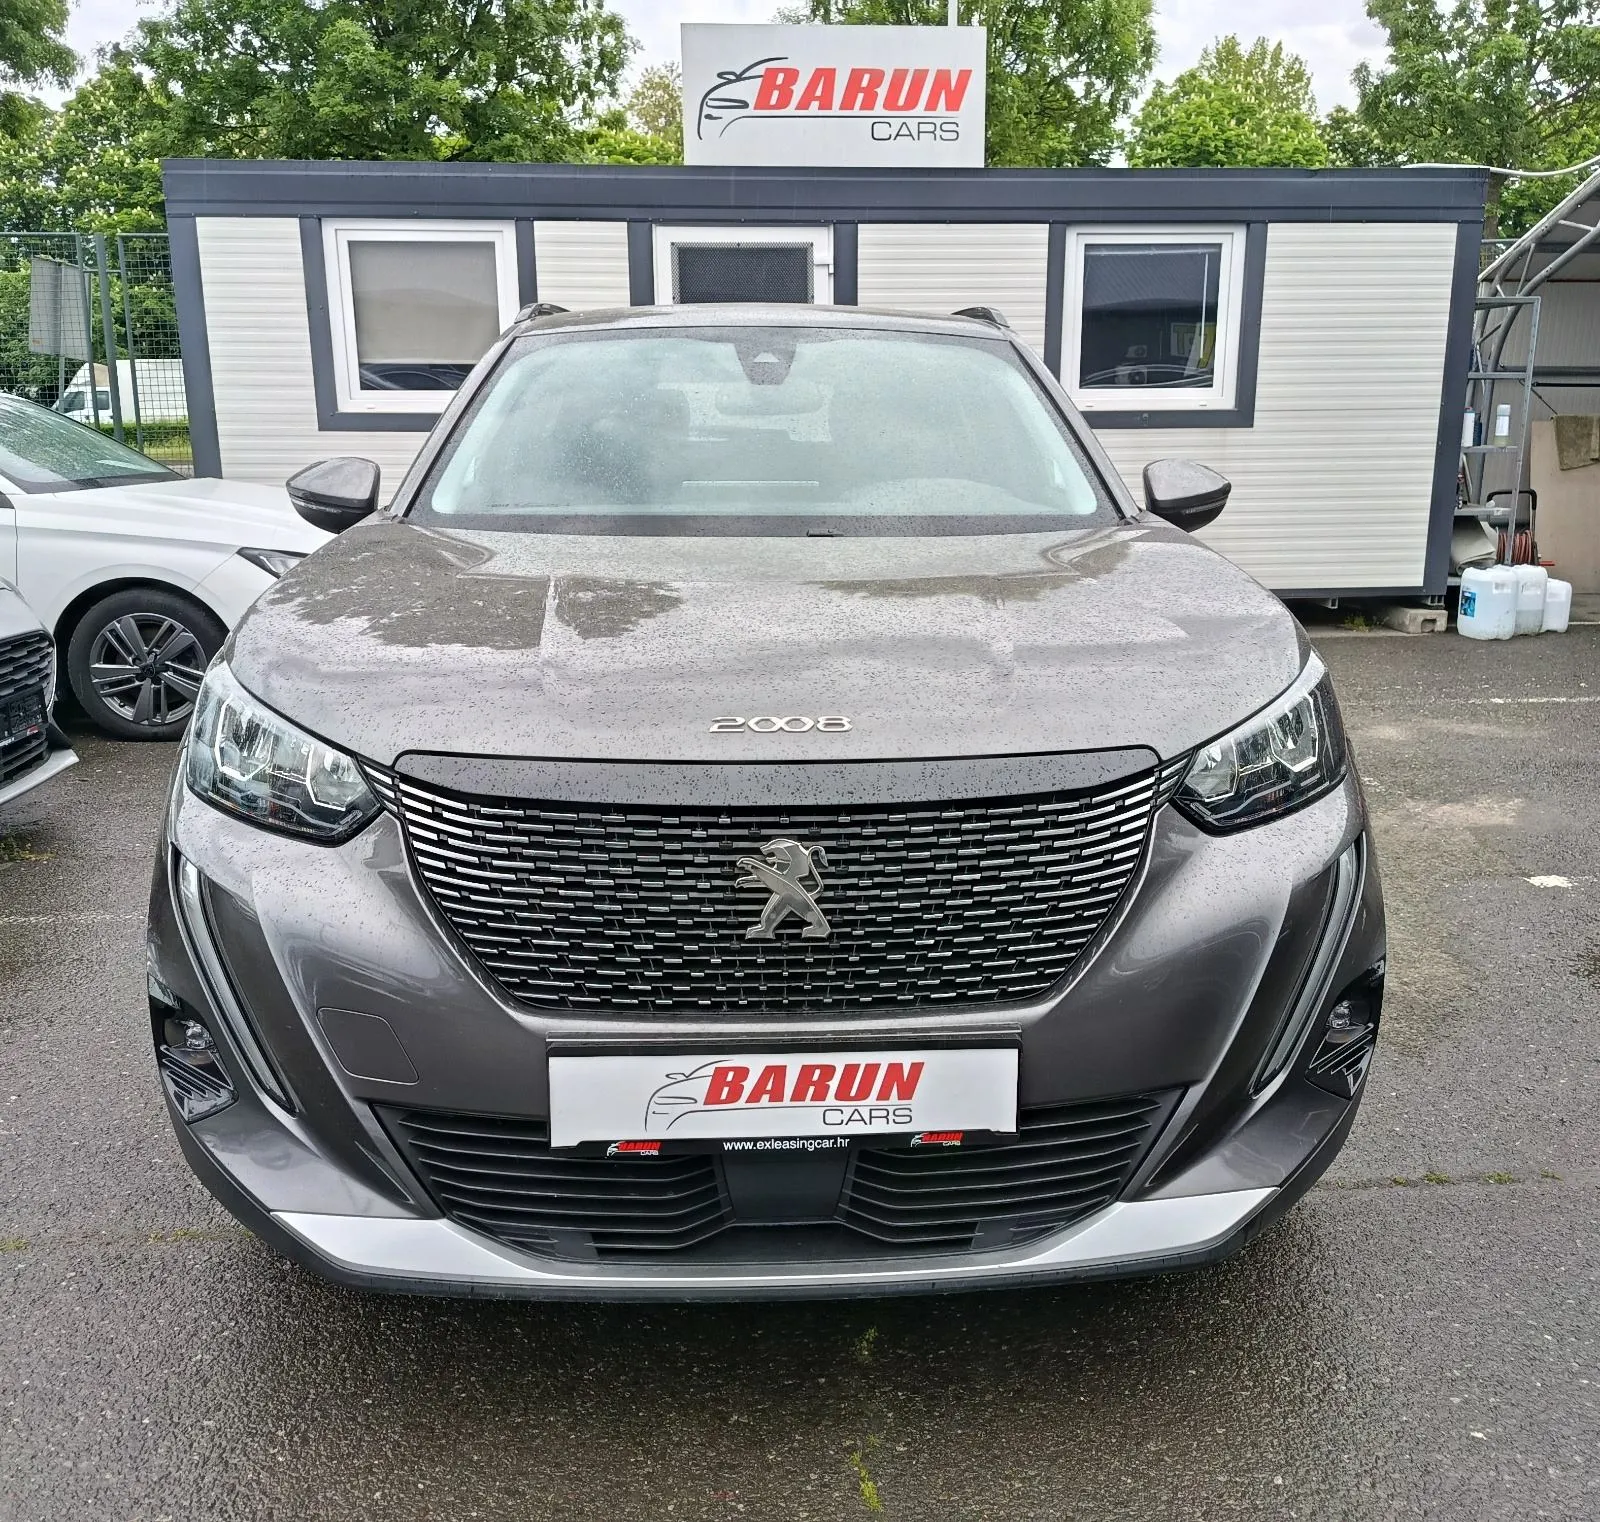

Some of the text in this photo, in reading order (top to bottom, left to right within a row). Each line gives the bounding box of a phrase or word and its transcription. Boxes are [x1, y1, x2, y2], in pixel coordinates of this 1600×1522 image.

[753, 67, 973, 112] BARUN
[871, 121, 959, 141] CARS
[709, 716, 853, 733] 2008
[703, 1062, 925, 1105] BARUN
[822, 1106, 913, 1126] CARS
[723, 1136, 850, 1151] www.exleasingcar.hr
